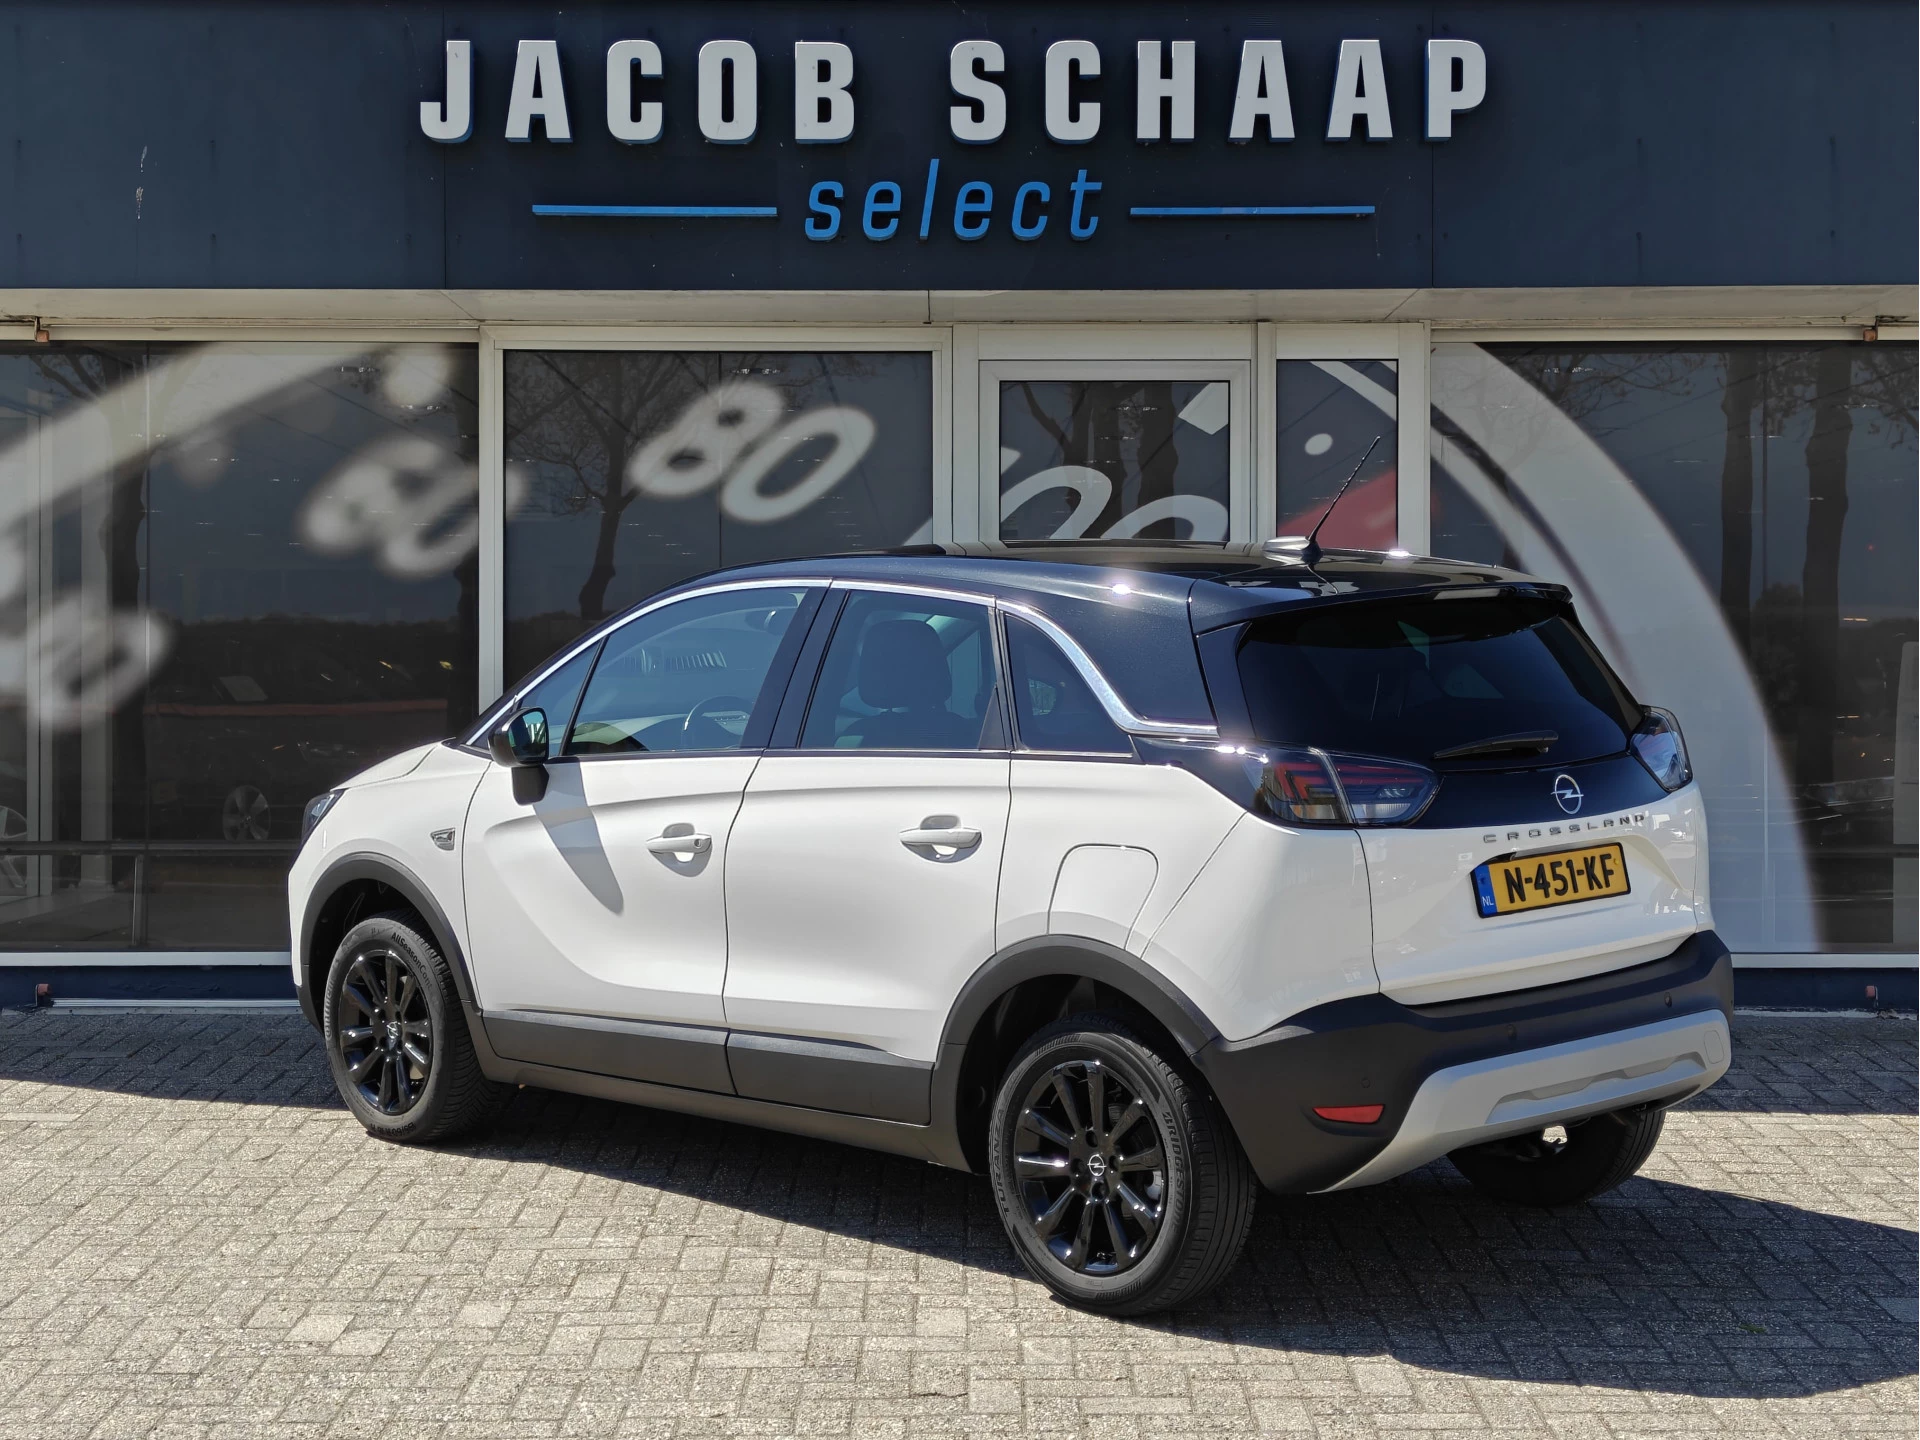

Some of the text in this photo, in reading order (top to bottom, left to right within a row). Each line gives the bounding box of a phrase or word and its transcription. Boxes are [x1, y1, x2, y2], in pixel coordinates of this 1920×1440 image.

[420, 39, 1487, 143] JACOB SCHAAP
[805, 158, 1102, 241] select
[1483, 814, 1645, 844] CROSSLAND
[1481, 895, 1495, 907] NL
[1504, 853, 1615, 904] N-451-KF
[993, 1108, 1010, 1218] TURANZA
[1162, 1111, 1186, 1233] BRIDGESTONE
